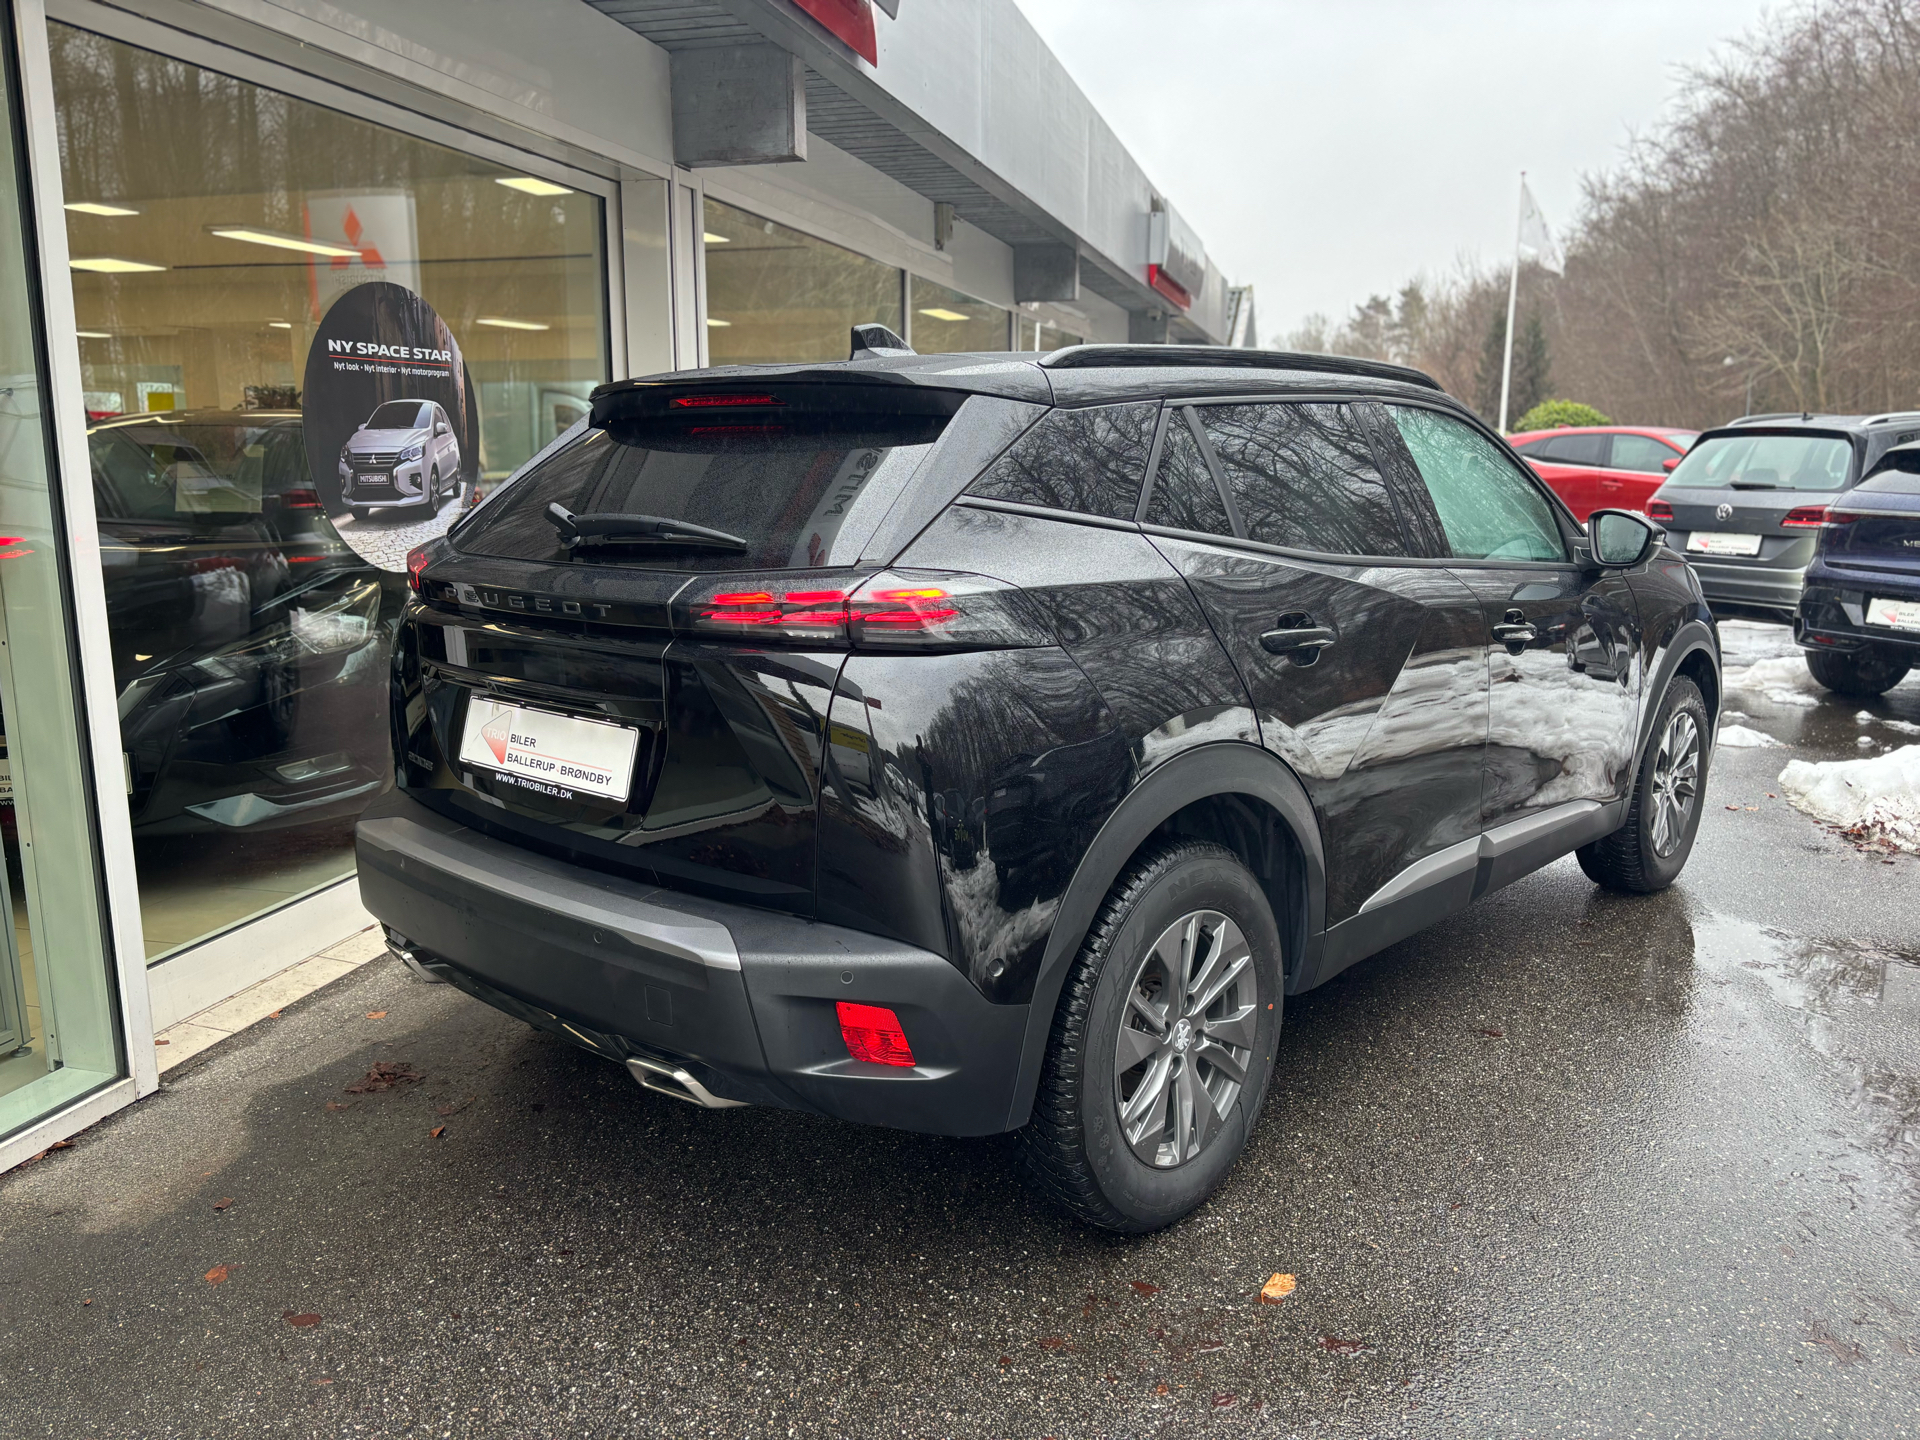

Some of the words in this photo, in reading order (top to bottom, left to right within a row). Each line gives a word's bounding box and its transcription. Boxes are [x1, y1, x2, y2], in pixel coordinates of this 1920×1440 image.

[328, 339, 354, 353] NY
[356, 342, 410, 359] SPACE
[413, 347, 452, 361] STAR
[333, 361, 346, 371] Nyt
[346, 362, 360, 371] look
[364, 364, 375, 374] Nyt
[376, 365, 397, 374] interior
[401, 366, 412, 376] Nyt
[412, 368, 450, 378] motorprogram
[359, 474, 388, 483] MITSUBISHI
[444, 587, 612, 617] PEUGEOT
[486, 727, 507, 742] TRIO
[510, 733, 537, 749] BILER
[507, 752, 556, 773] BALLERUP
[560, 765, 613, 786] BRØNDBY
[495, 772, 573, 800] WWW.TRIOBILER.DK
[1167, 867, 1257, 900] NEXEN
